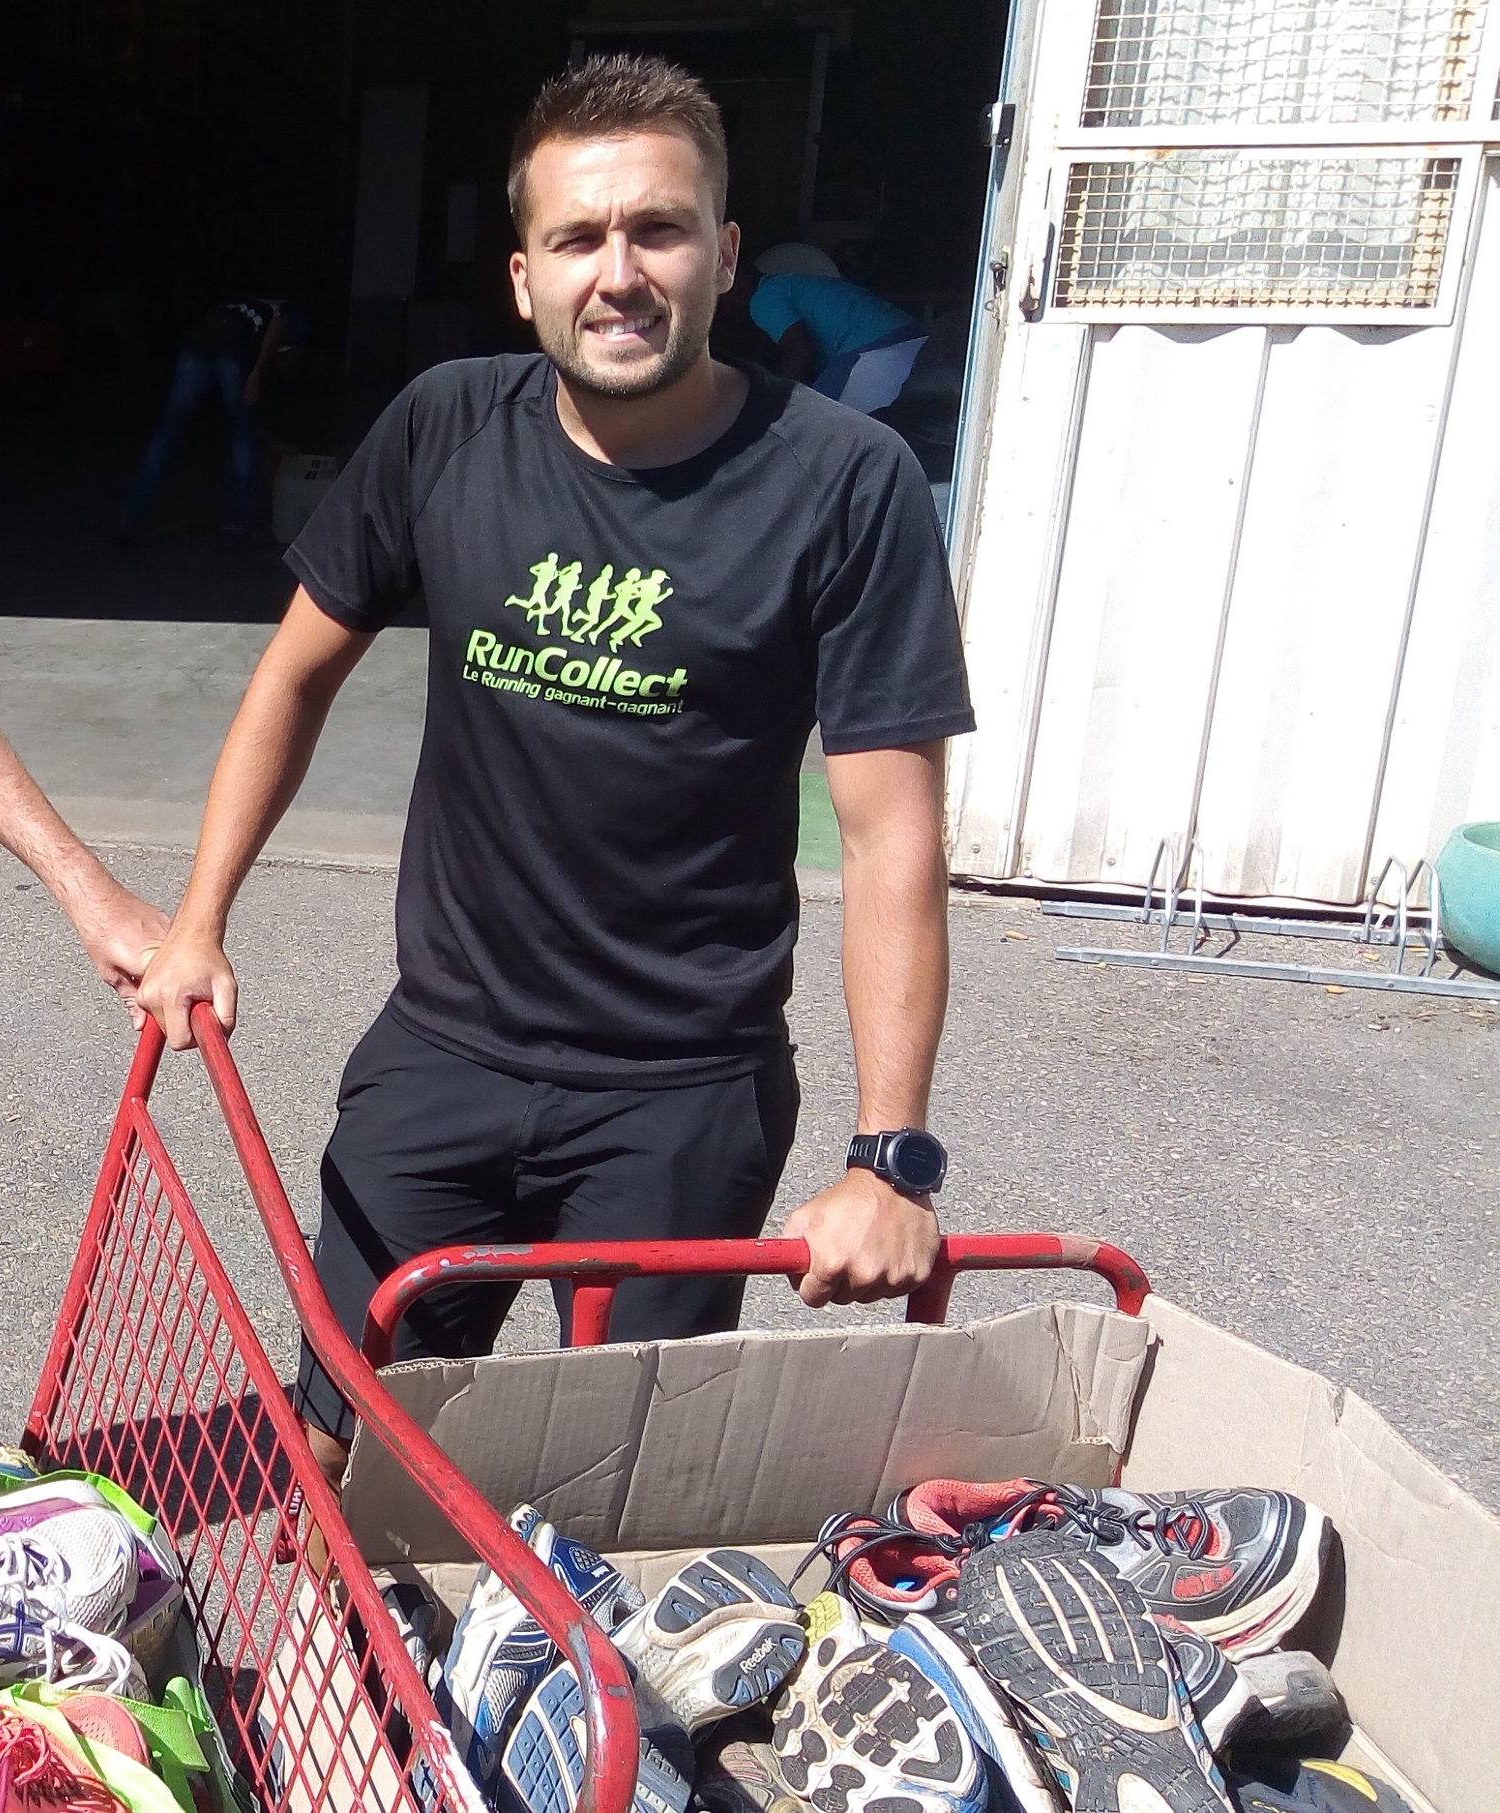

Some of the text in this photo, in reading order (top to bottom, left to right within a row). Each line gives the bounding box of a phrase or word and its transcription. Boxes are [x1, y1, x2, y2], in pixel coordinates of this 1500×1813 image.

[466, 629, 688, 697] RunCollect
[462, 664, 685, 716] Le Running gagnant-gagnant
[739, 1636, 778, 1675] Reebok
